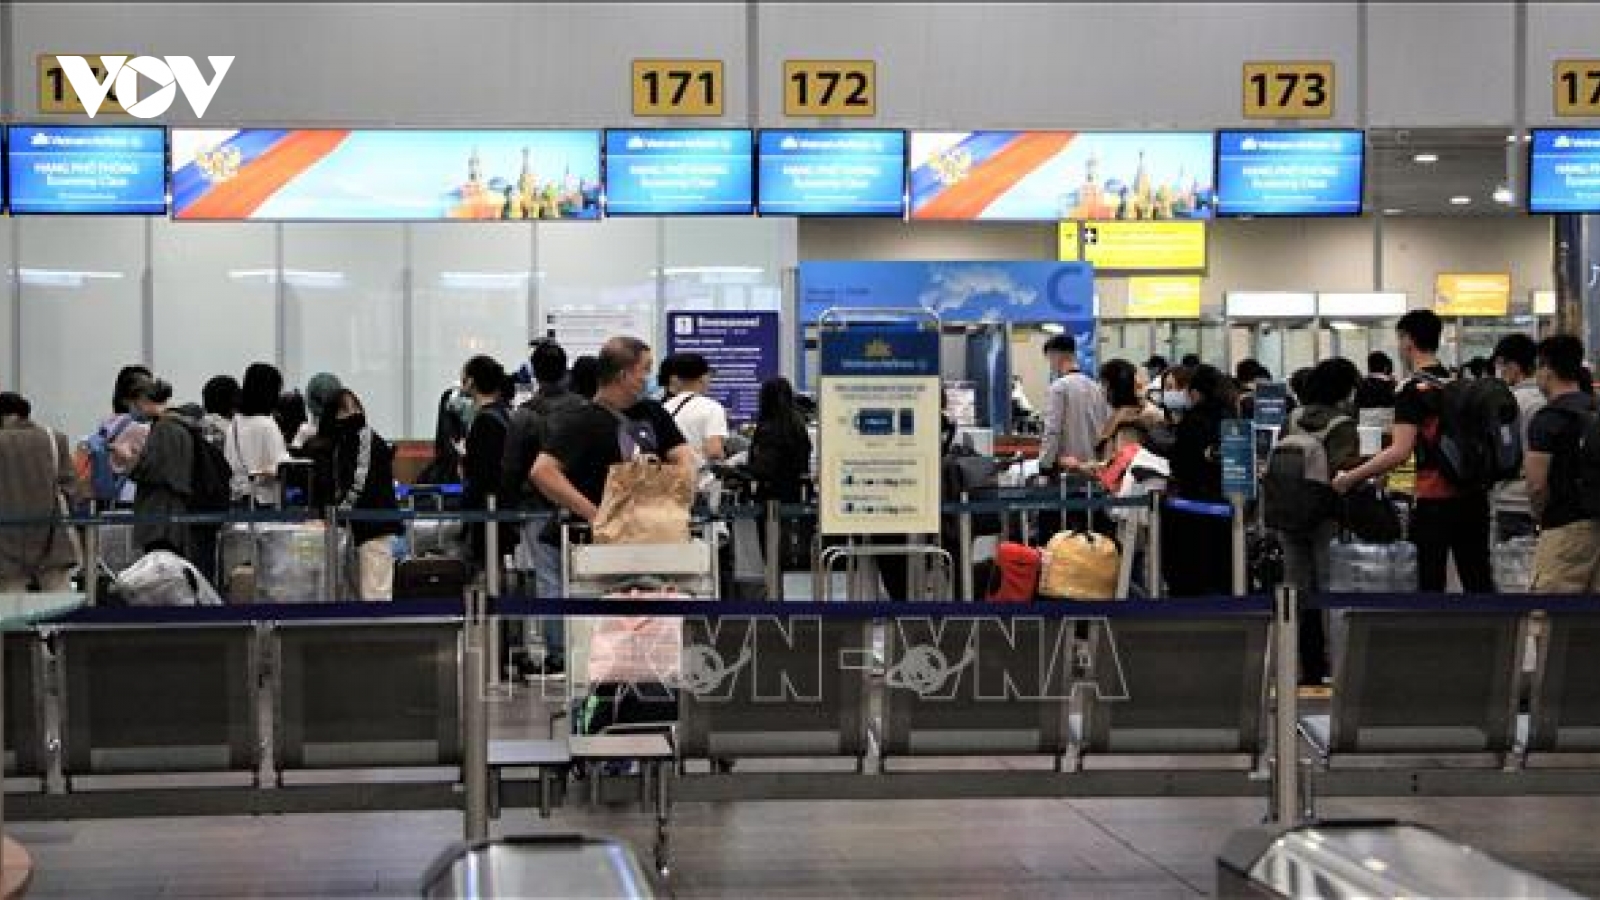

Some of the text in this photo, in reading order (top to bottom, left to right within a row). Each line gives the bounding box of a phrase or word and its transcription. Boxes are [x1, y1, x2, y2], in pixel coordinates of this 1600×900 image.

[642, 71, 714, 106] 171
[791, 71, 868, 106] 172
[1250, 72, 1326, 107] 173
[1047, 265, 1083, 313] C
